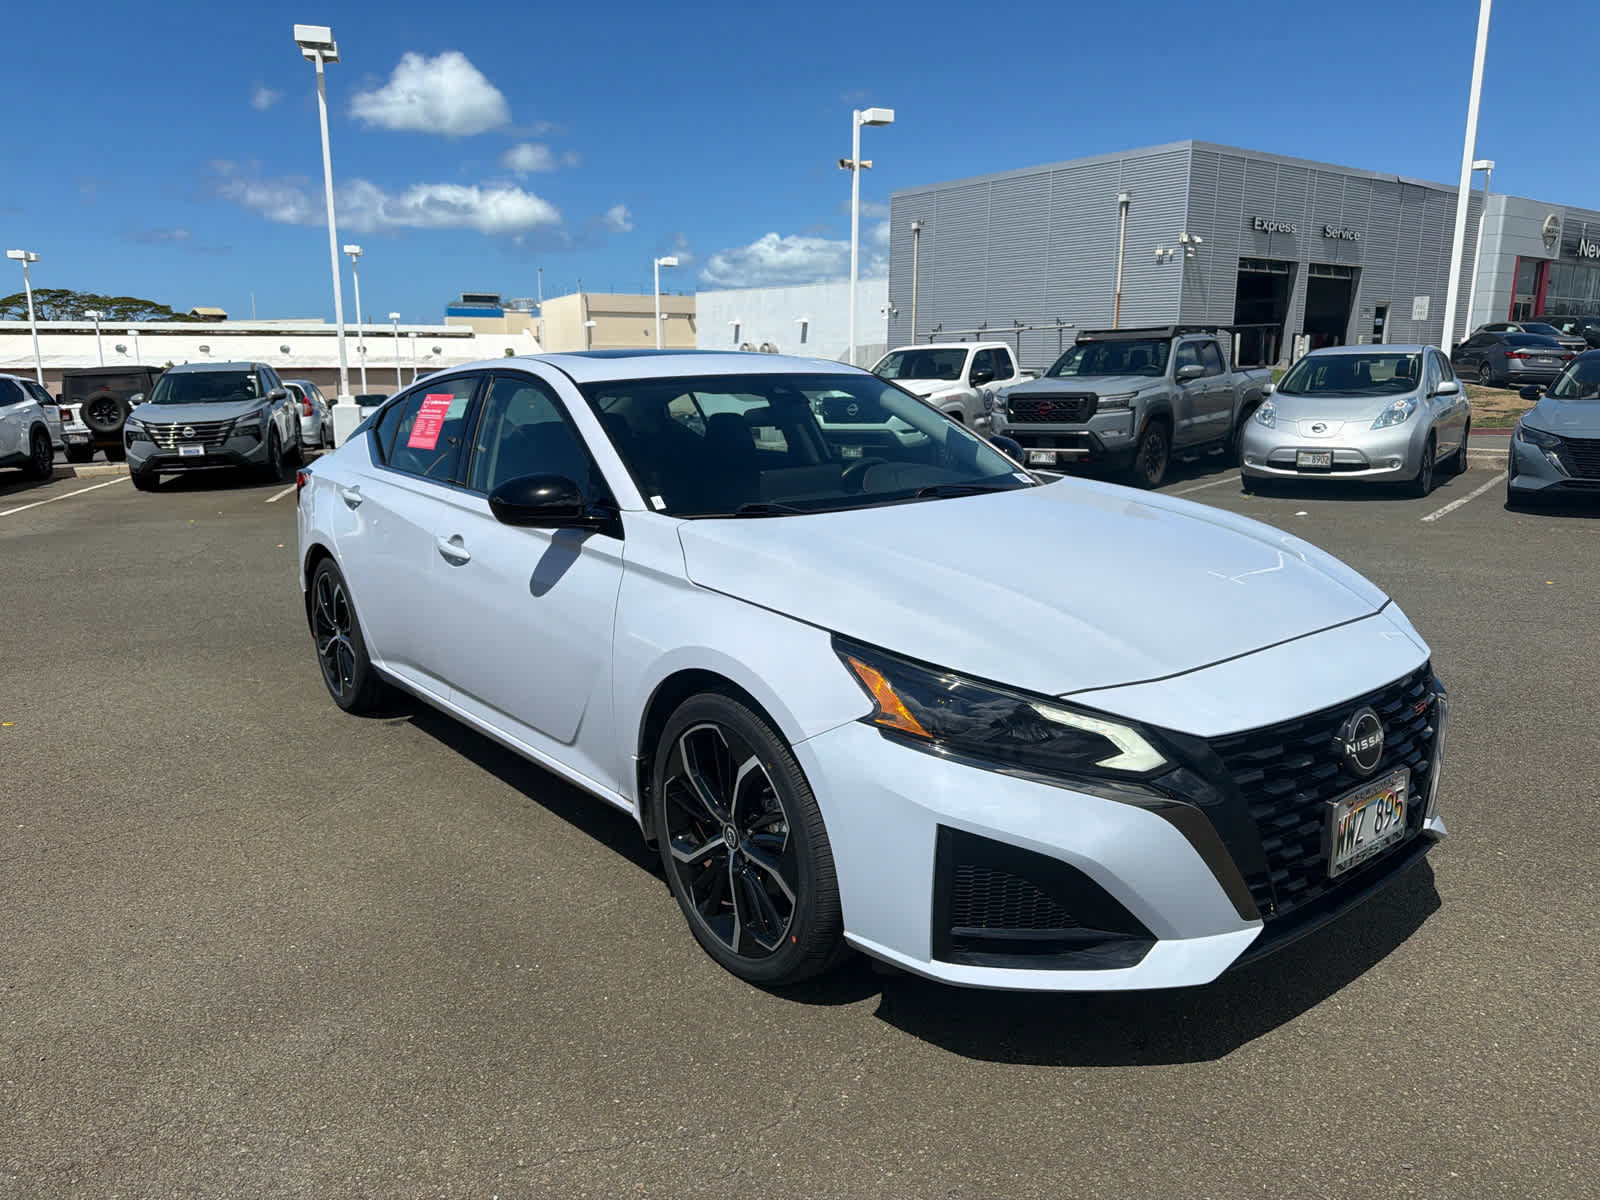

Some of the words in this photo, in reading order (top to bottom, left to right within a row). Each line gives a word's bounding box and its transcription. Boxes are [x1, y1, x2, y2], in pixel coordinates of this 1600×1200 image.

[1254, 217, 1297, 234] Express
[1325, 224, 1360, 240] Service
[1375, 787, 1403, 833] 895
